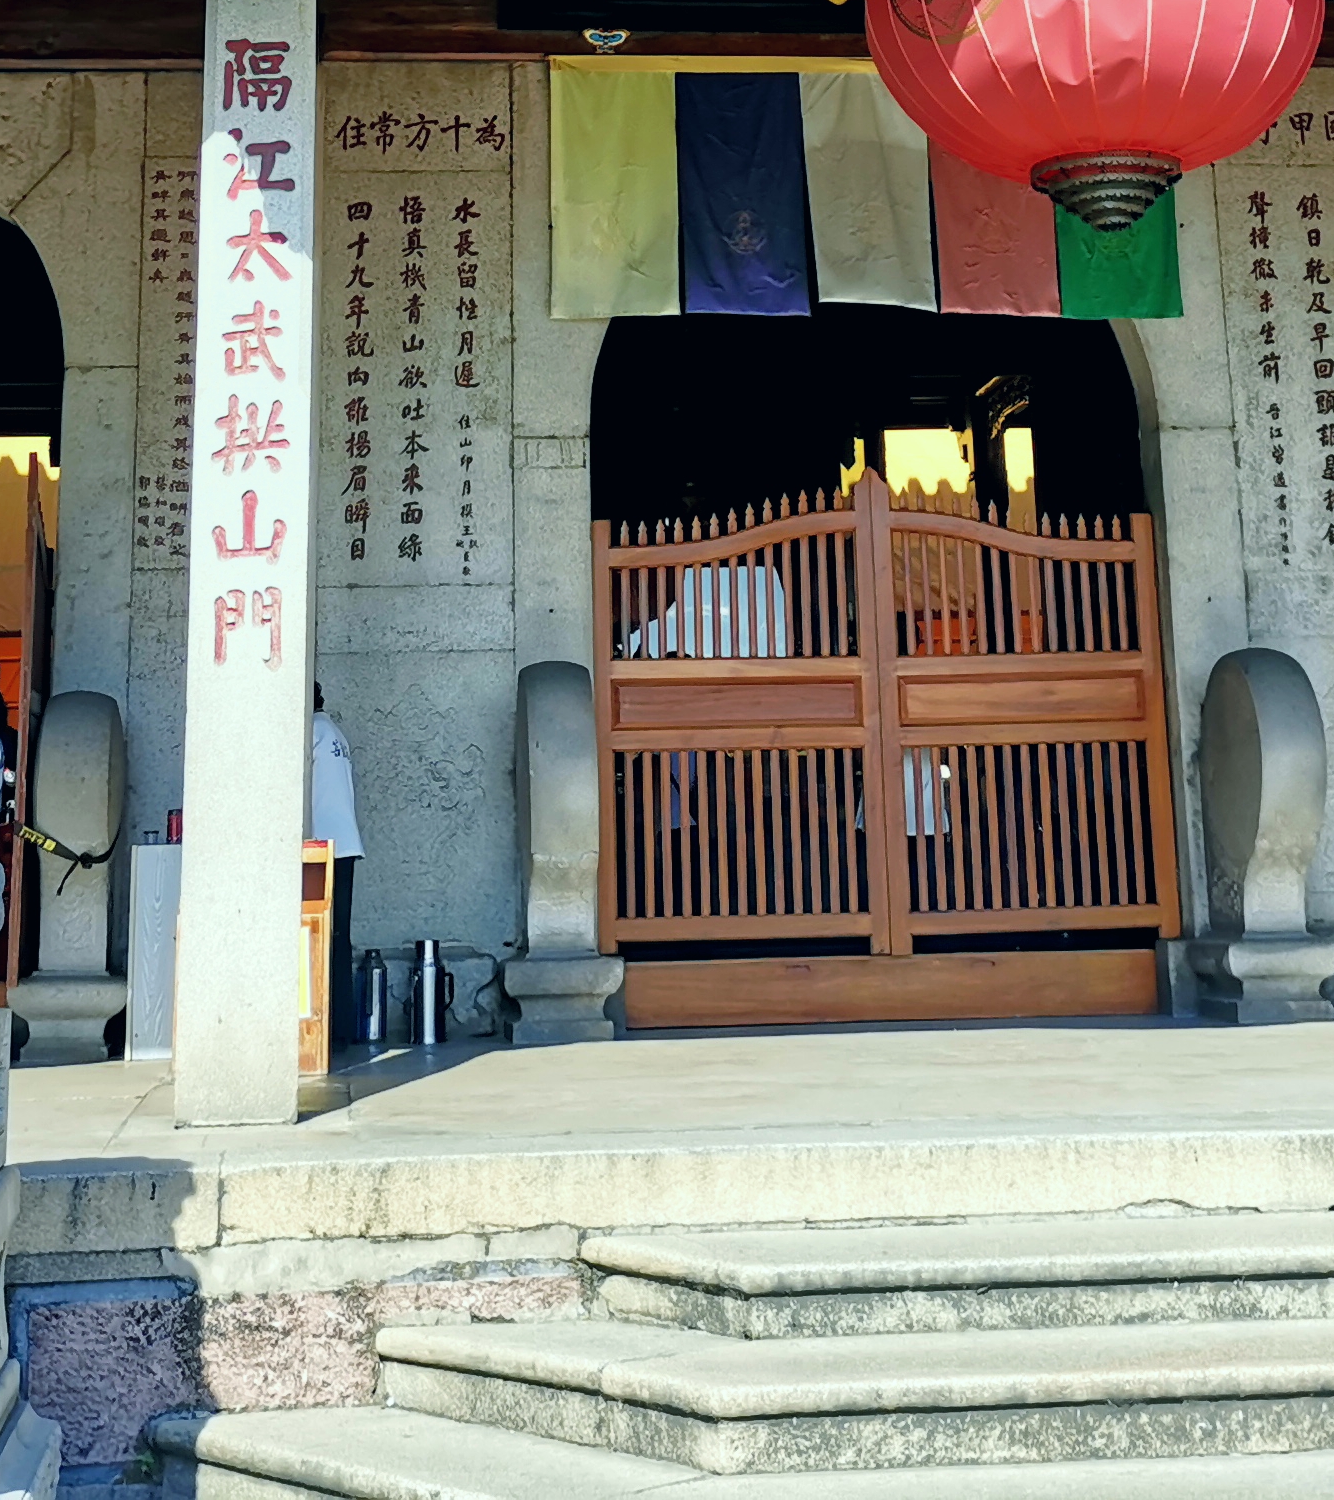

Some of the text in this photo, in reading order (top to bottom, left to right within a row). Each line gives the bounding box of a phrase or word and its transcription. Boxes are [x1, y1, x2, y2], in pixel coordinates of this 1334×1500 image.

[210, 38, 296, 673] 隔江太武拱山門
